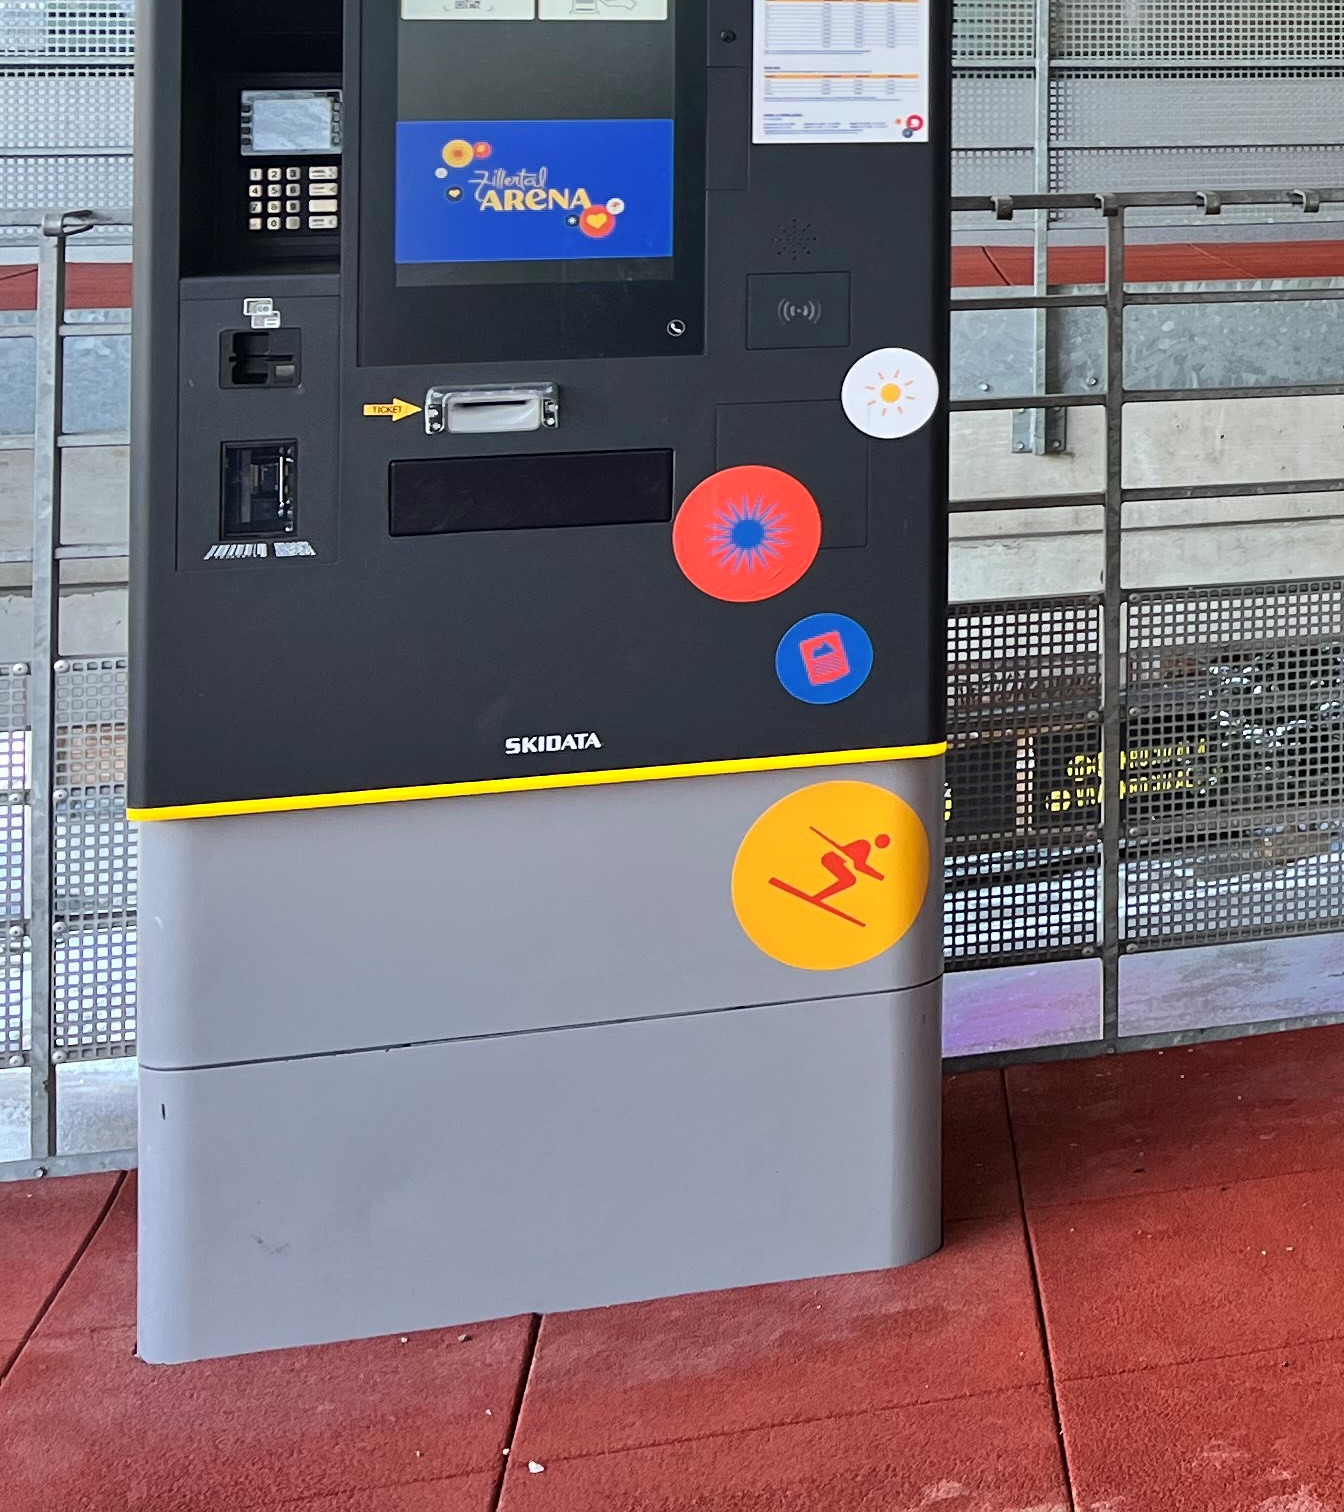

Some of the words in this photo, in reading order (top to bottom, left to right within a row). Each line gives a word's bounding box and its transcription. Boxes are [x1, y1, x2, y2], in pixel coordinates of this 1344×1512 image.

[468, 166, 548, 202] Zillertal
[480, 188, 593, 211] ARENA
[373, 405, 402, 414] TICKET
[505, 731, 601, 754] SKIDATA
